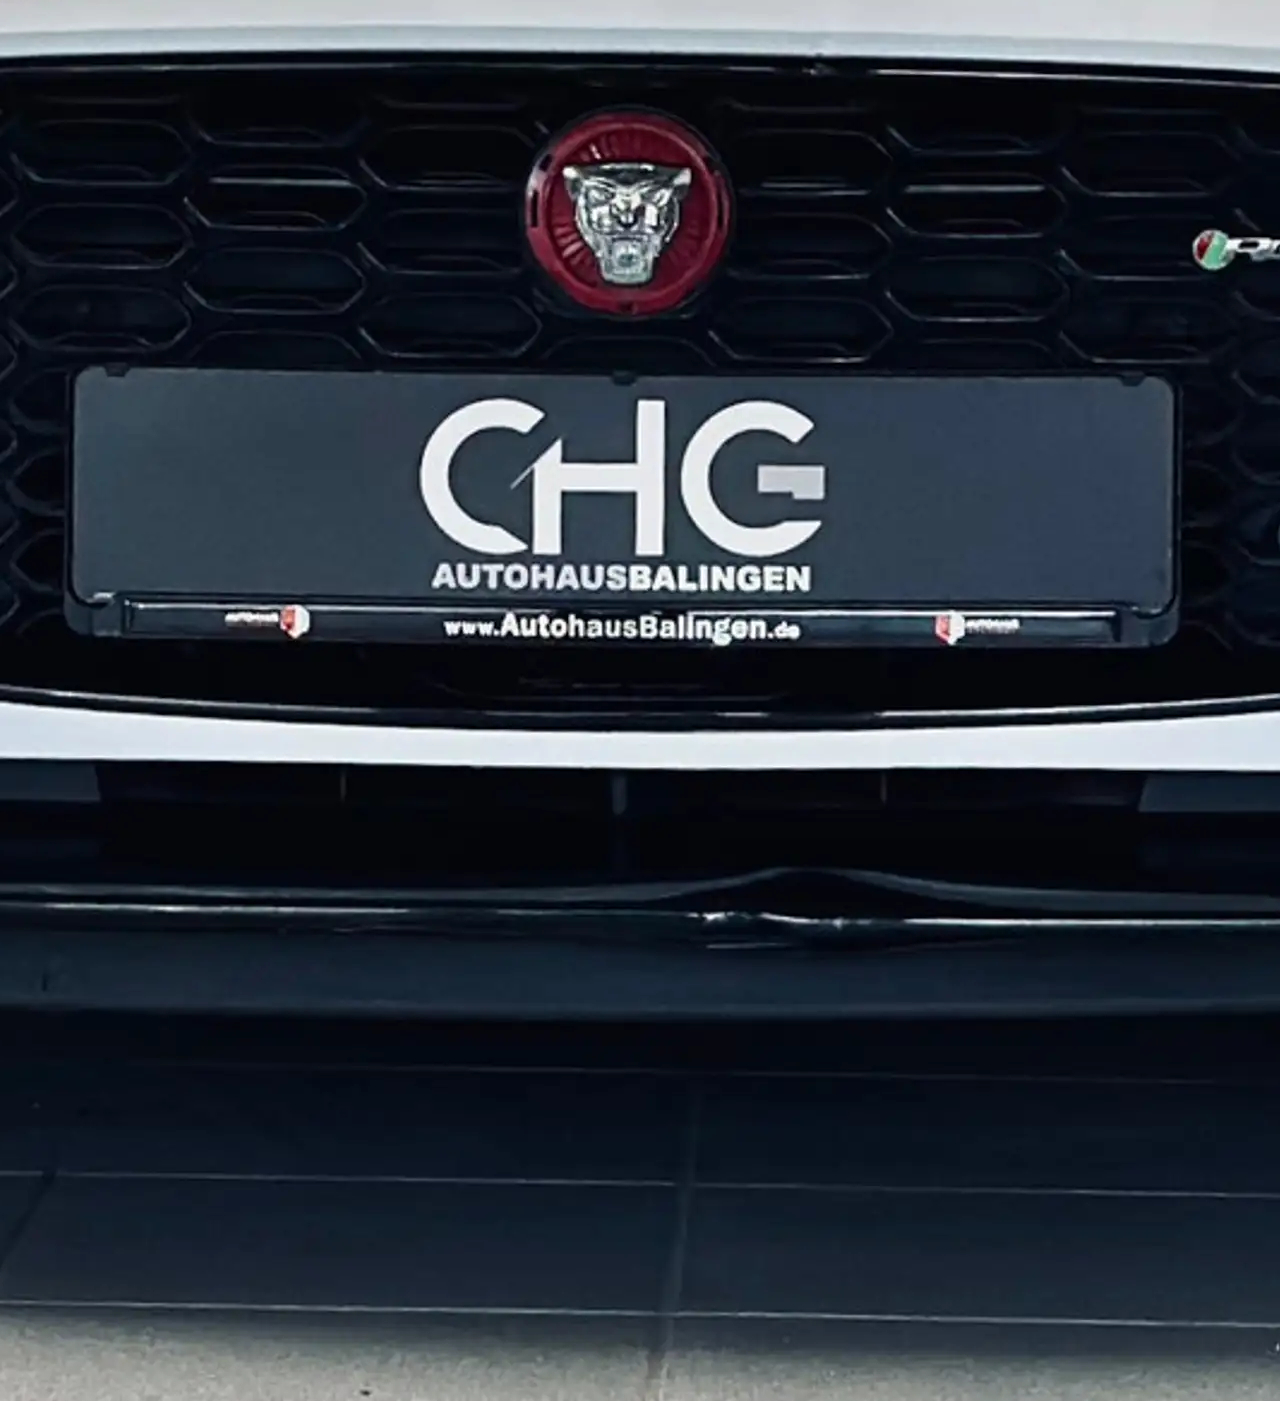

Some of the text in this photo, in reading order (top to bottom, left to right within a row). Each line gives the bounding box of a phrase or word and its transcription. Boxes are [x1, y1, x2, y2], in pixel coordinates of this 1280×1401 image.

[420, 397, 825, 558] CHG
[431, 564, 812, 592] AUTOHAUSBALINGEN
[443, 610, 801, 646] www.AutohausBalingen.de
